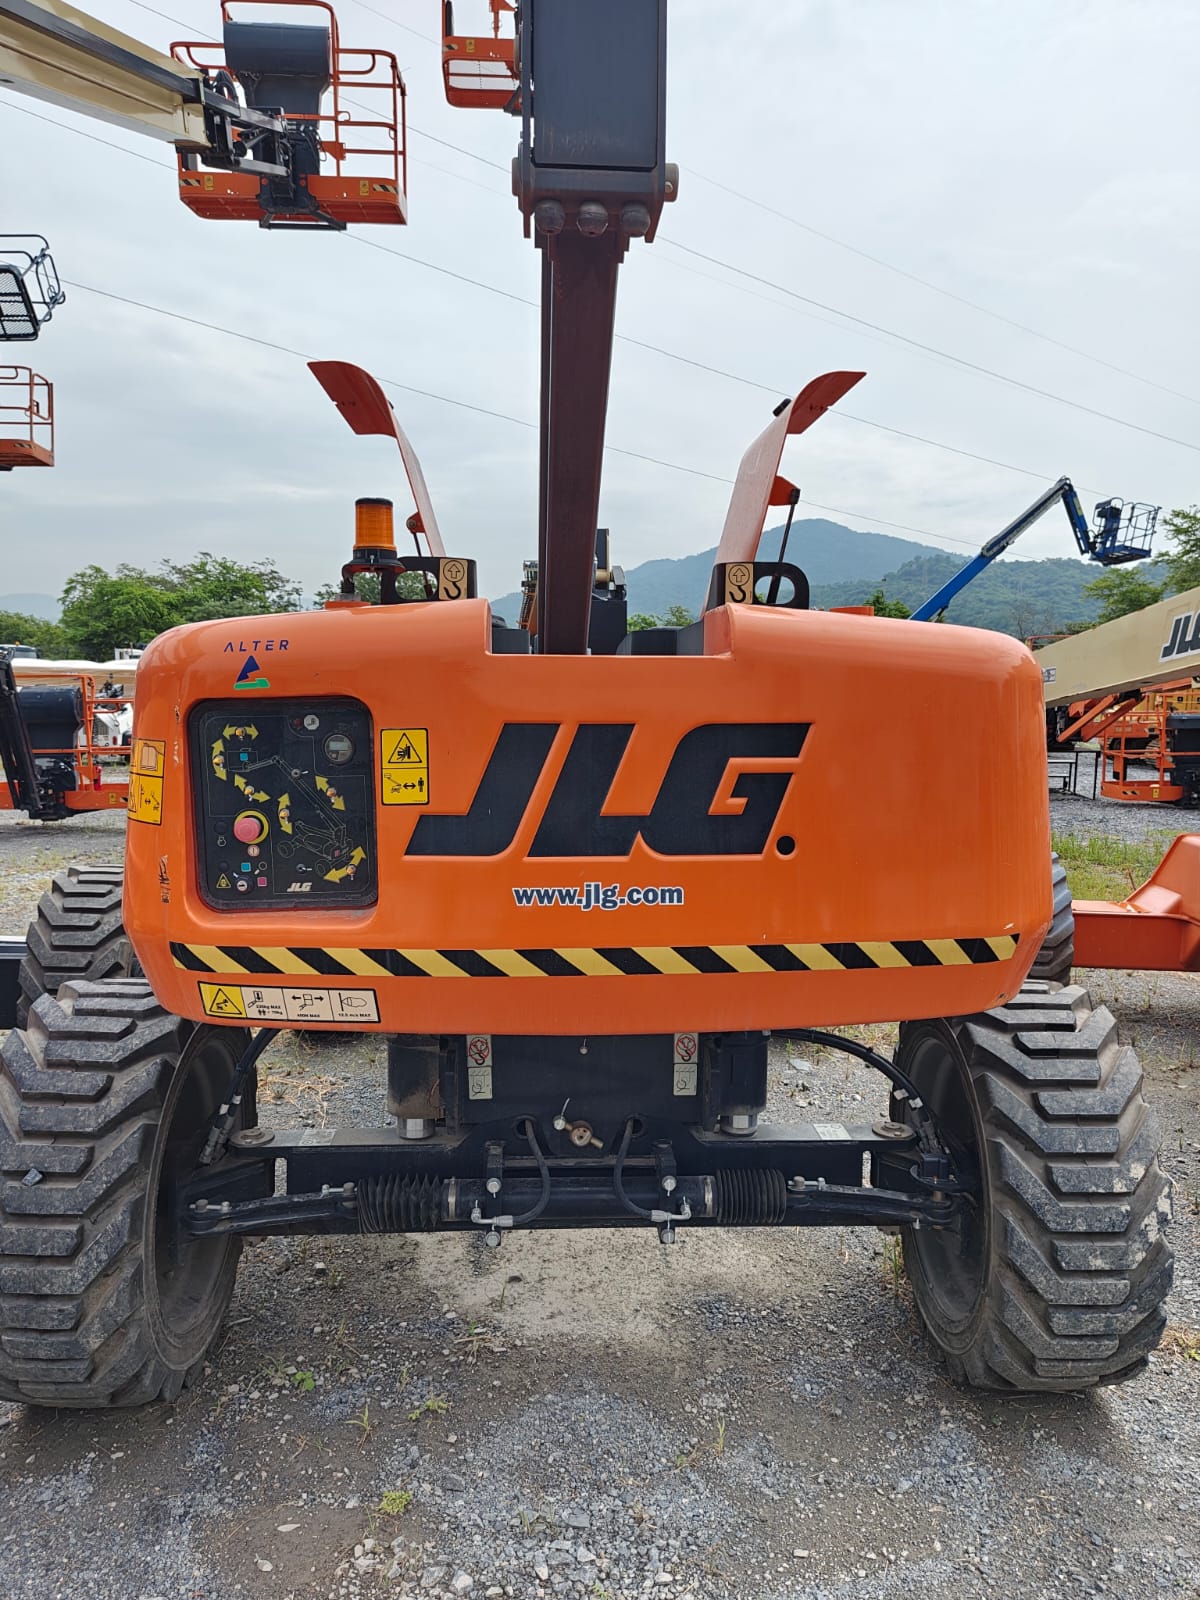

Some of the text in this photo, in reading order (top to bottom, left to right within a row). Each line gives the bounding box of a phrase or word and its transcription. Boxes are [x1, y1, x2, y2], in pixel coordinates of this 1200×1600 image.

[223, 639, 289, 653] ALTER
[403, 722, 813, 857] JLG
[286, 881, 313, 893] JLG
[512, 882, 685, 911] www.jlg.com
